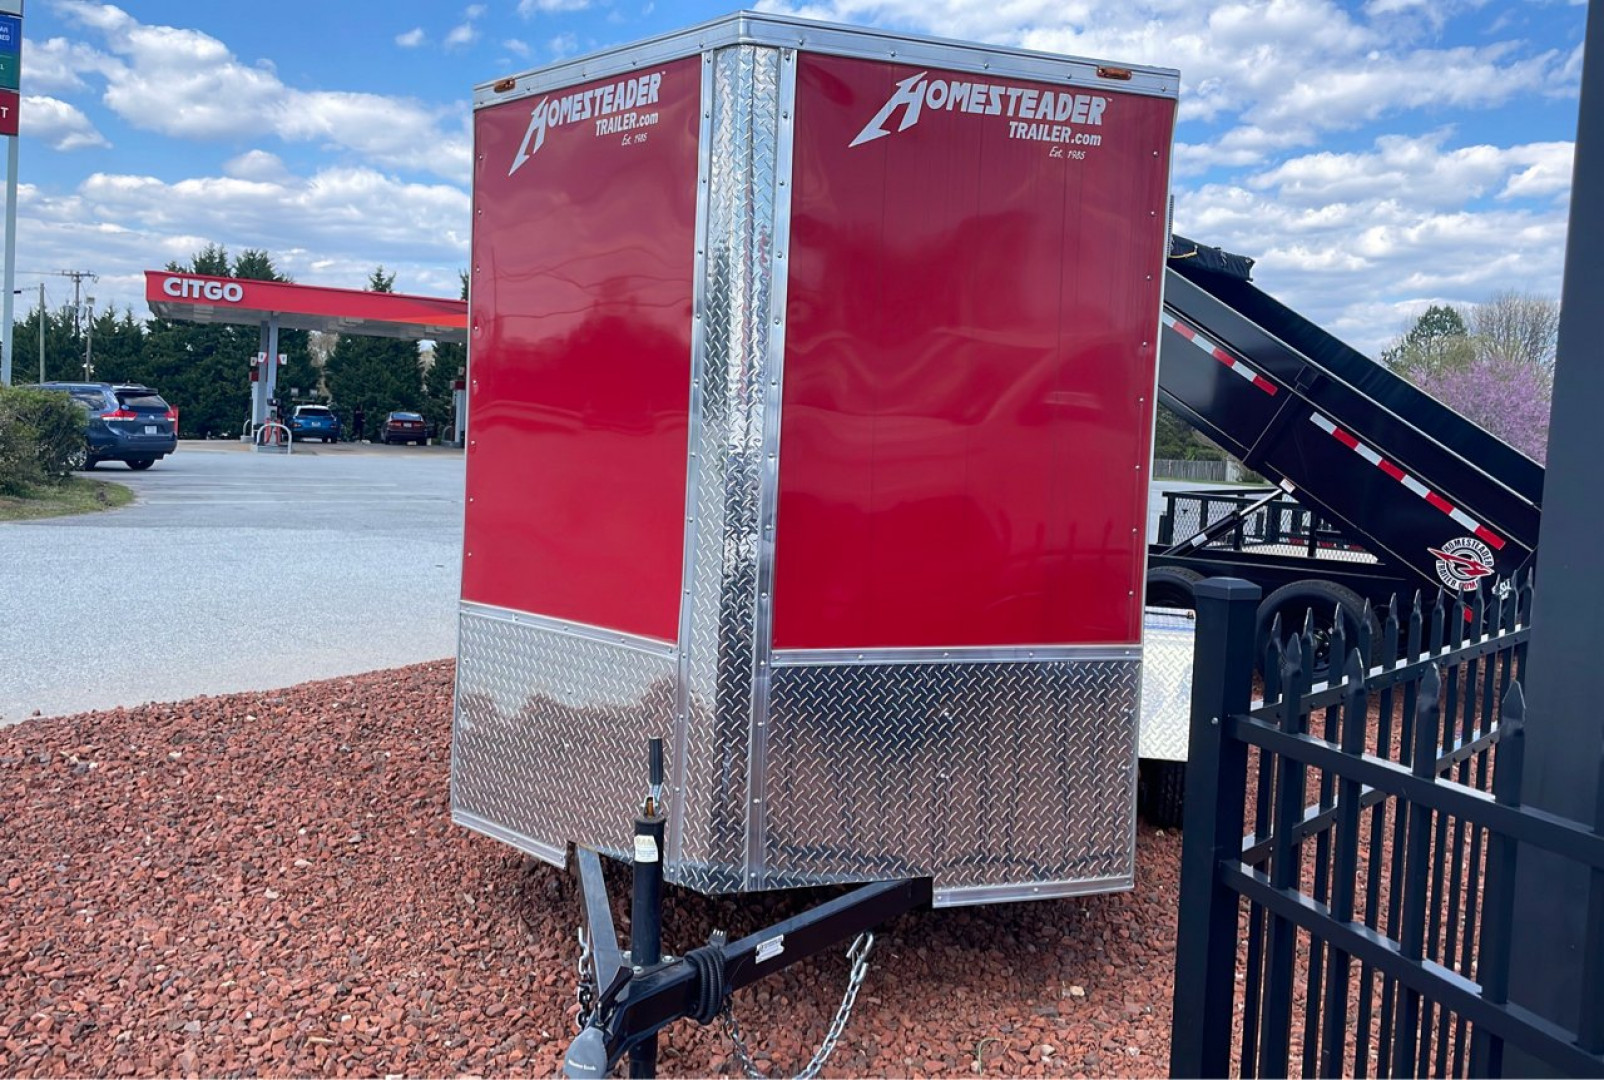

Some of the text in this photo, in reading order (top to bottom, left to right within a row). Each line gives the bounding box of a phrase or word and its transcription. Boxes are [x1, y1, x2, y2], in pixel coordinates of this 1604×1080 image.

[848, 71, 1107, 148] HOMESTEADER
[509, 73, 662, 176] HOMESTEADER
[596, 112, 659, 137] TRAILER.com
[1009, 121, 1102, 146] TRAILER.com
[1067, 149, 1086, 160] 1985
[163, 276, 243, 302] CITGO
[1443, 538, 1493, 566] HOMESTEADER
